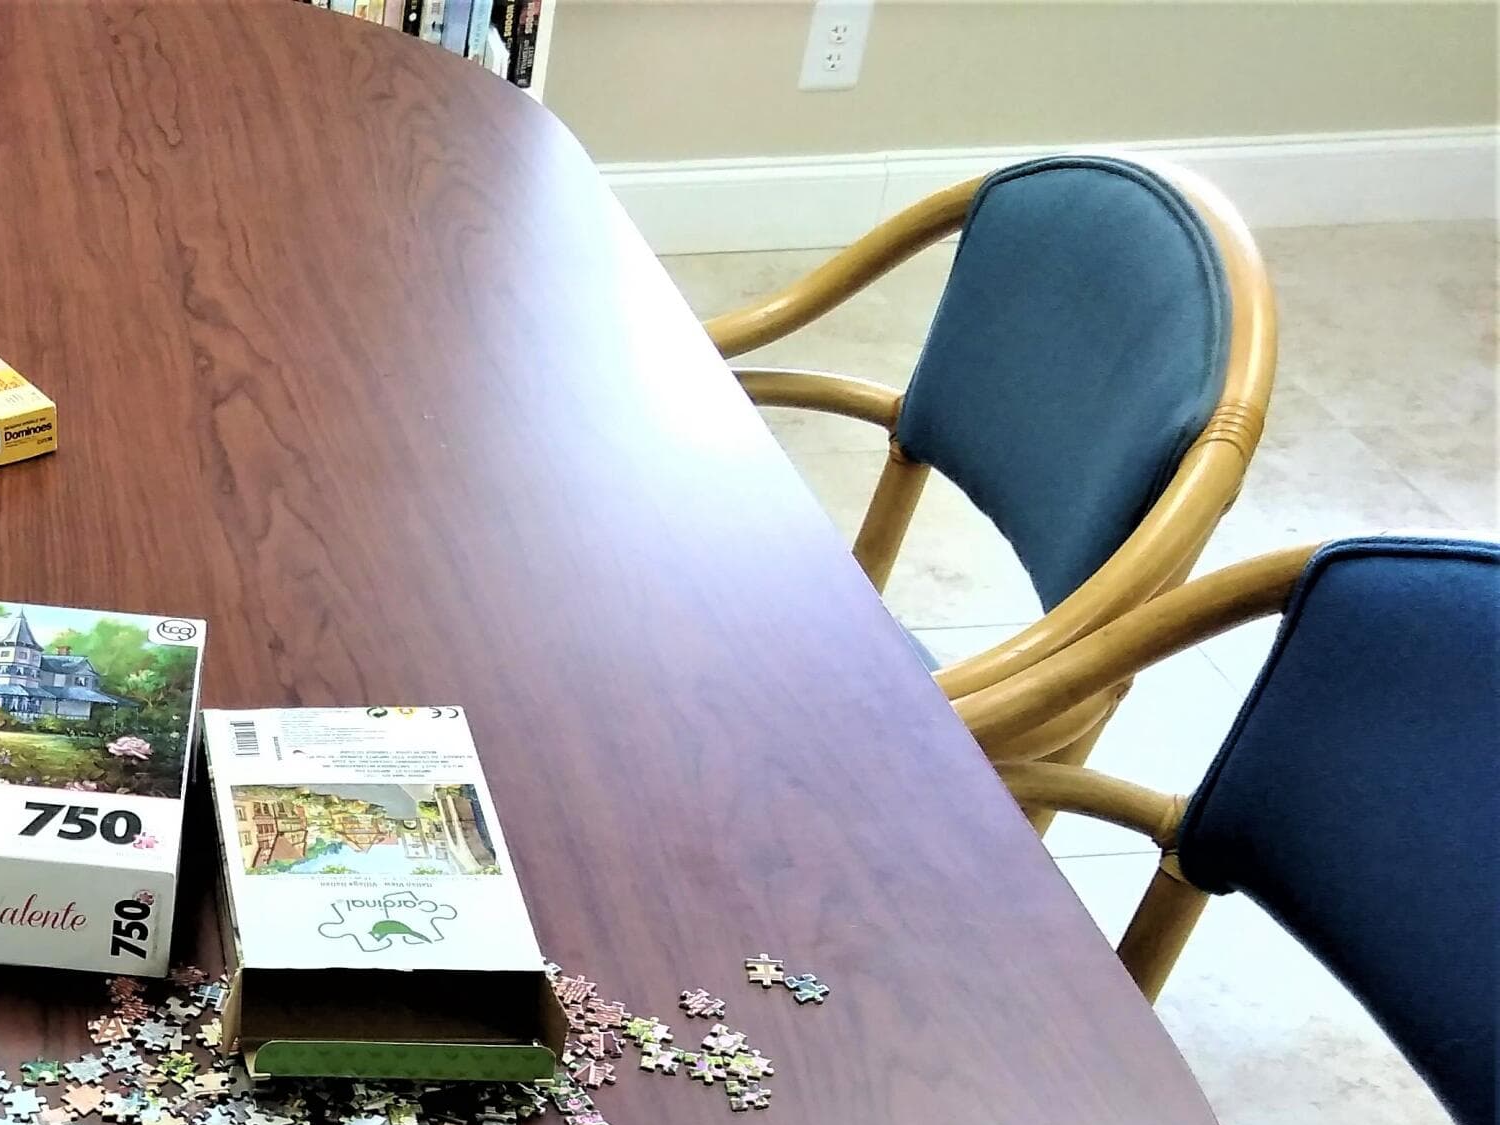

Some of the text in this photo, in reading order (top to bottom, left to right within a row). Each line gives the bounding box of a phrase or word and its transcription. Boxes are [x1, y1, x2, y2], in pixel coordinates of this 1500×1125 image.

[3, 421, 53, 442] Dominoes
[18, 801, 142, 846] 750
[348, 898, 440, 913] Cardinal
[110, 898, 152, 960] 750
